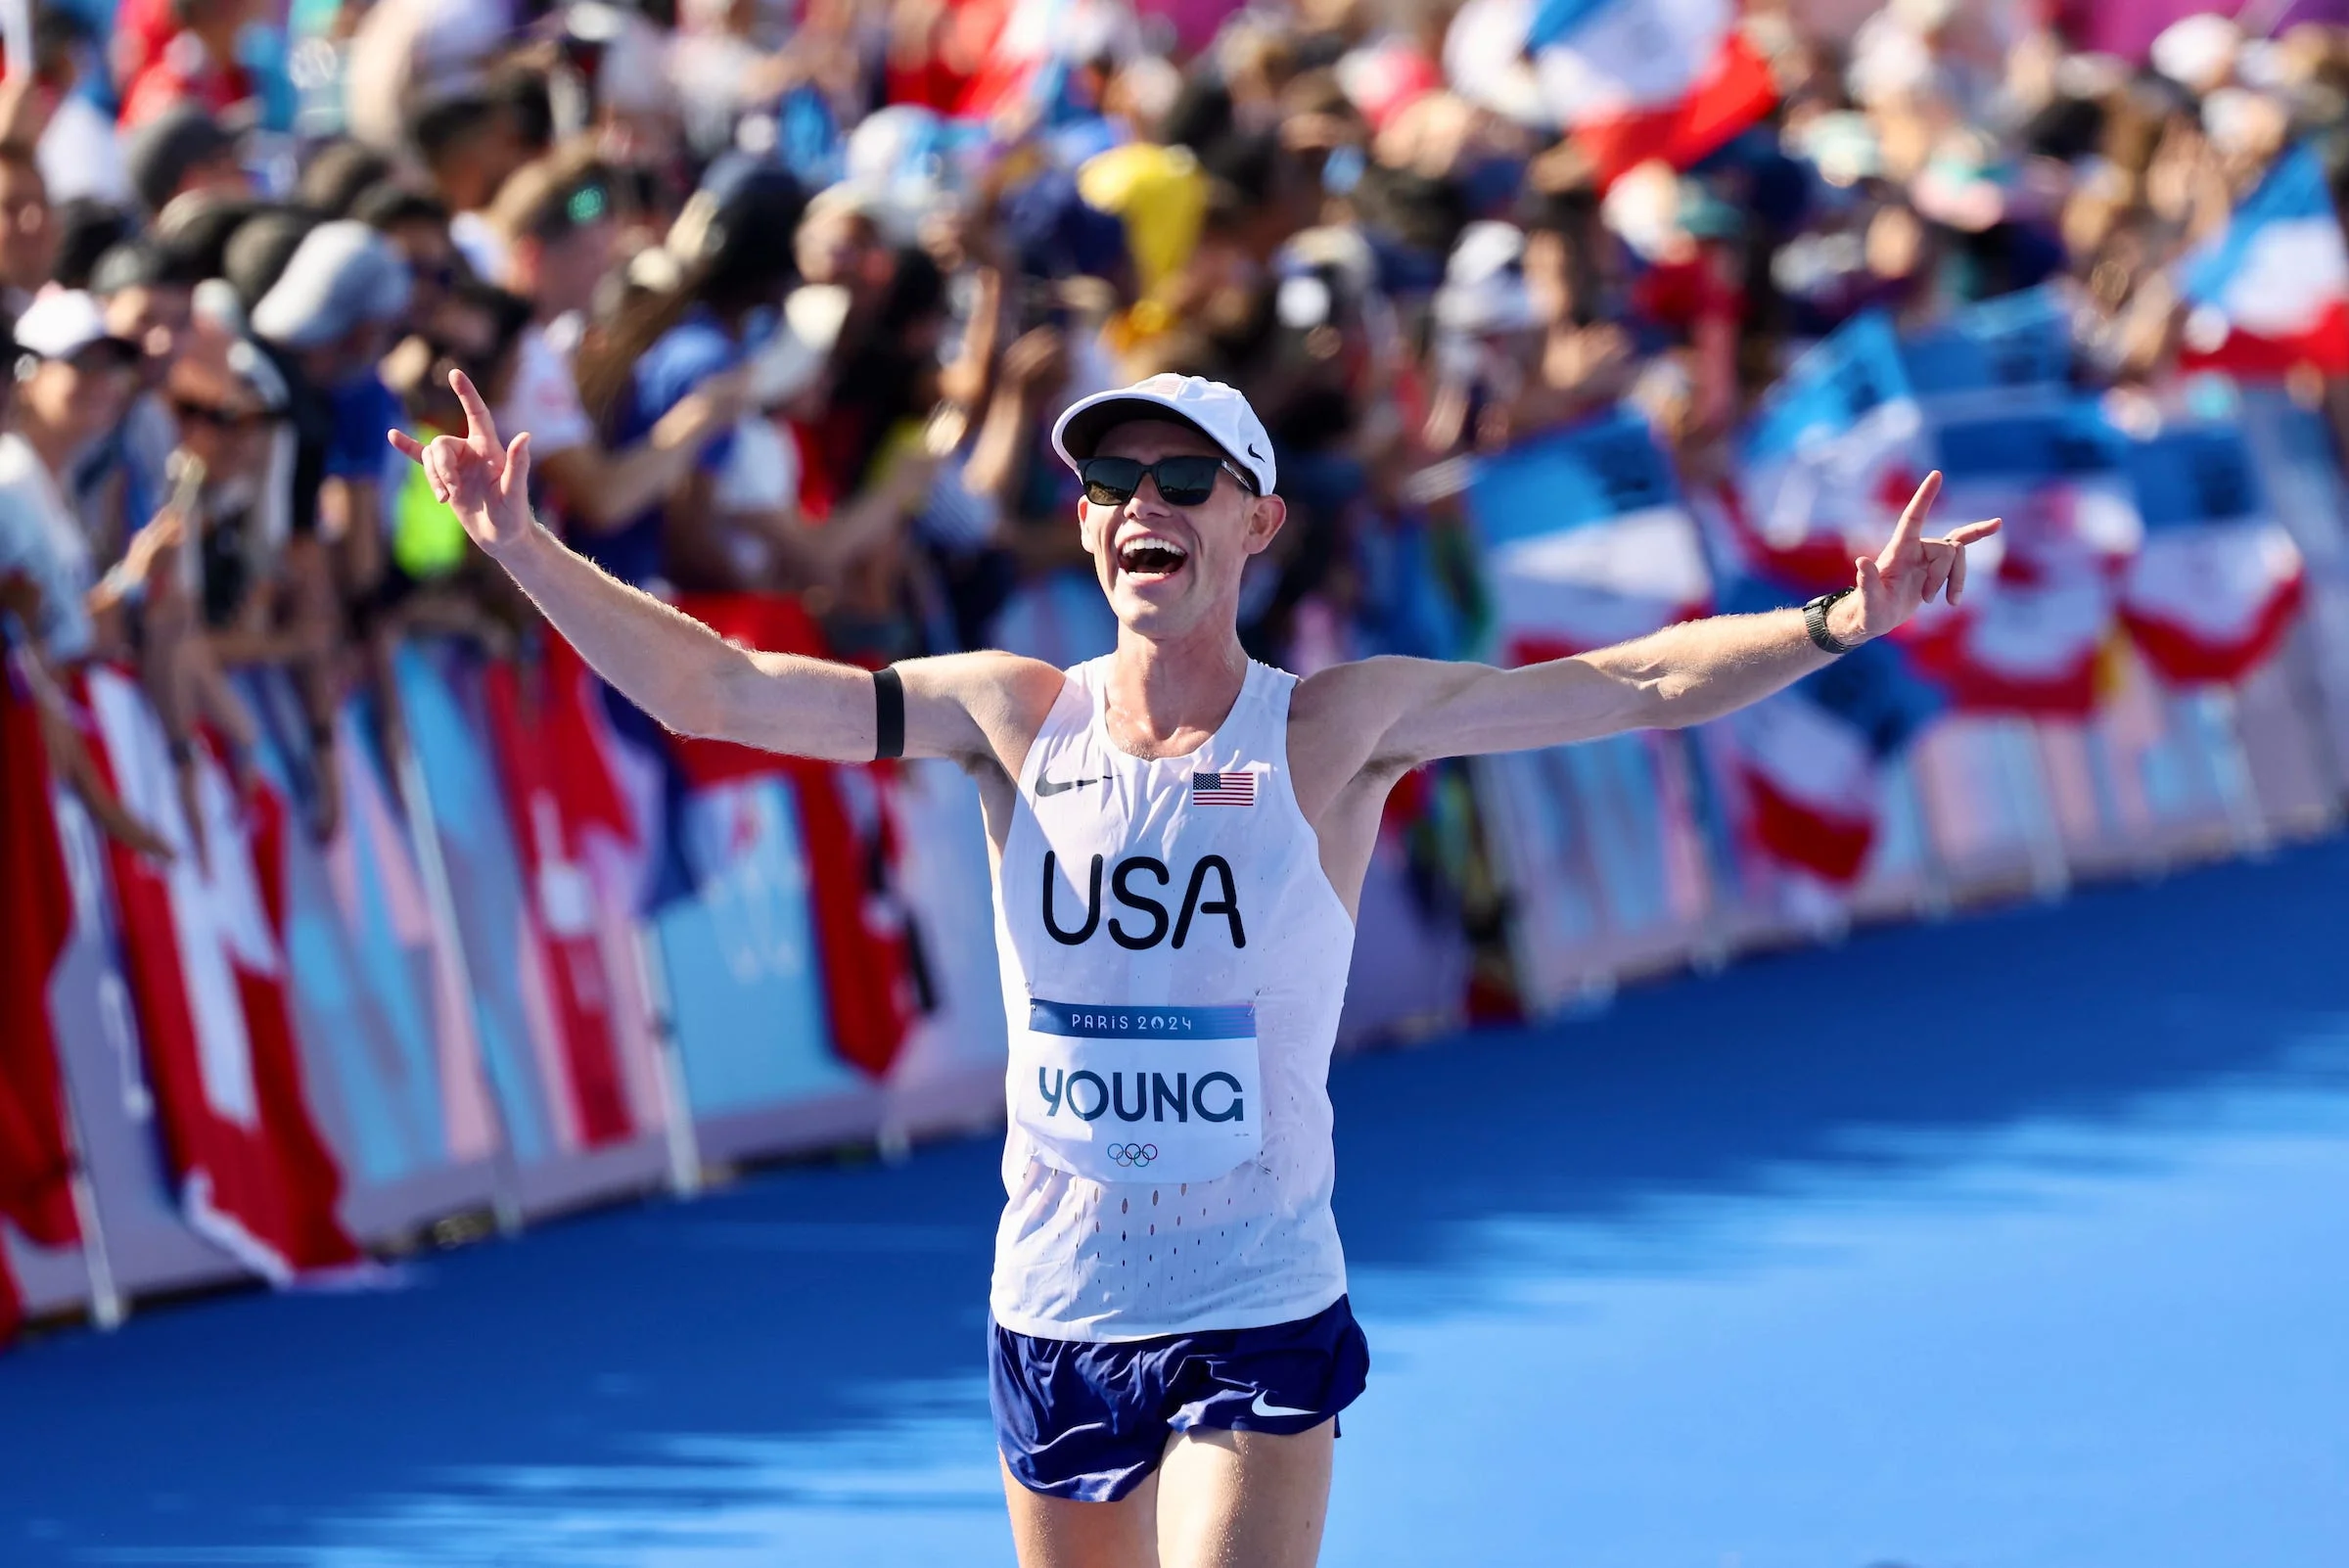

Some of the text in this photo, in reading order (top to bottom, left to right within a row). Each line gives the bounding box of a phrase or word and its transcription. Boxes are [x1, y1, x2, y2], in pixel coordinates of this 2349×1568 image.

[1042, 851, 1246, 949] USA
[1137, 1016, 1192, 1030] 2024
[1038, 1066, 1244, 1123] YOUNG
